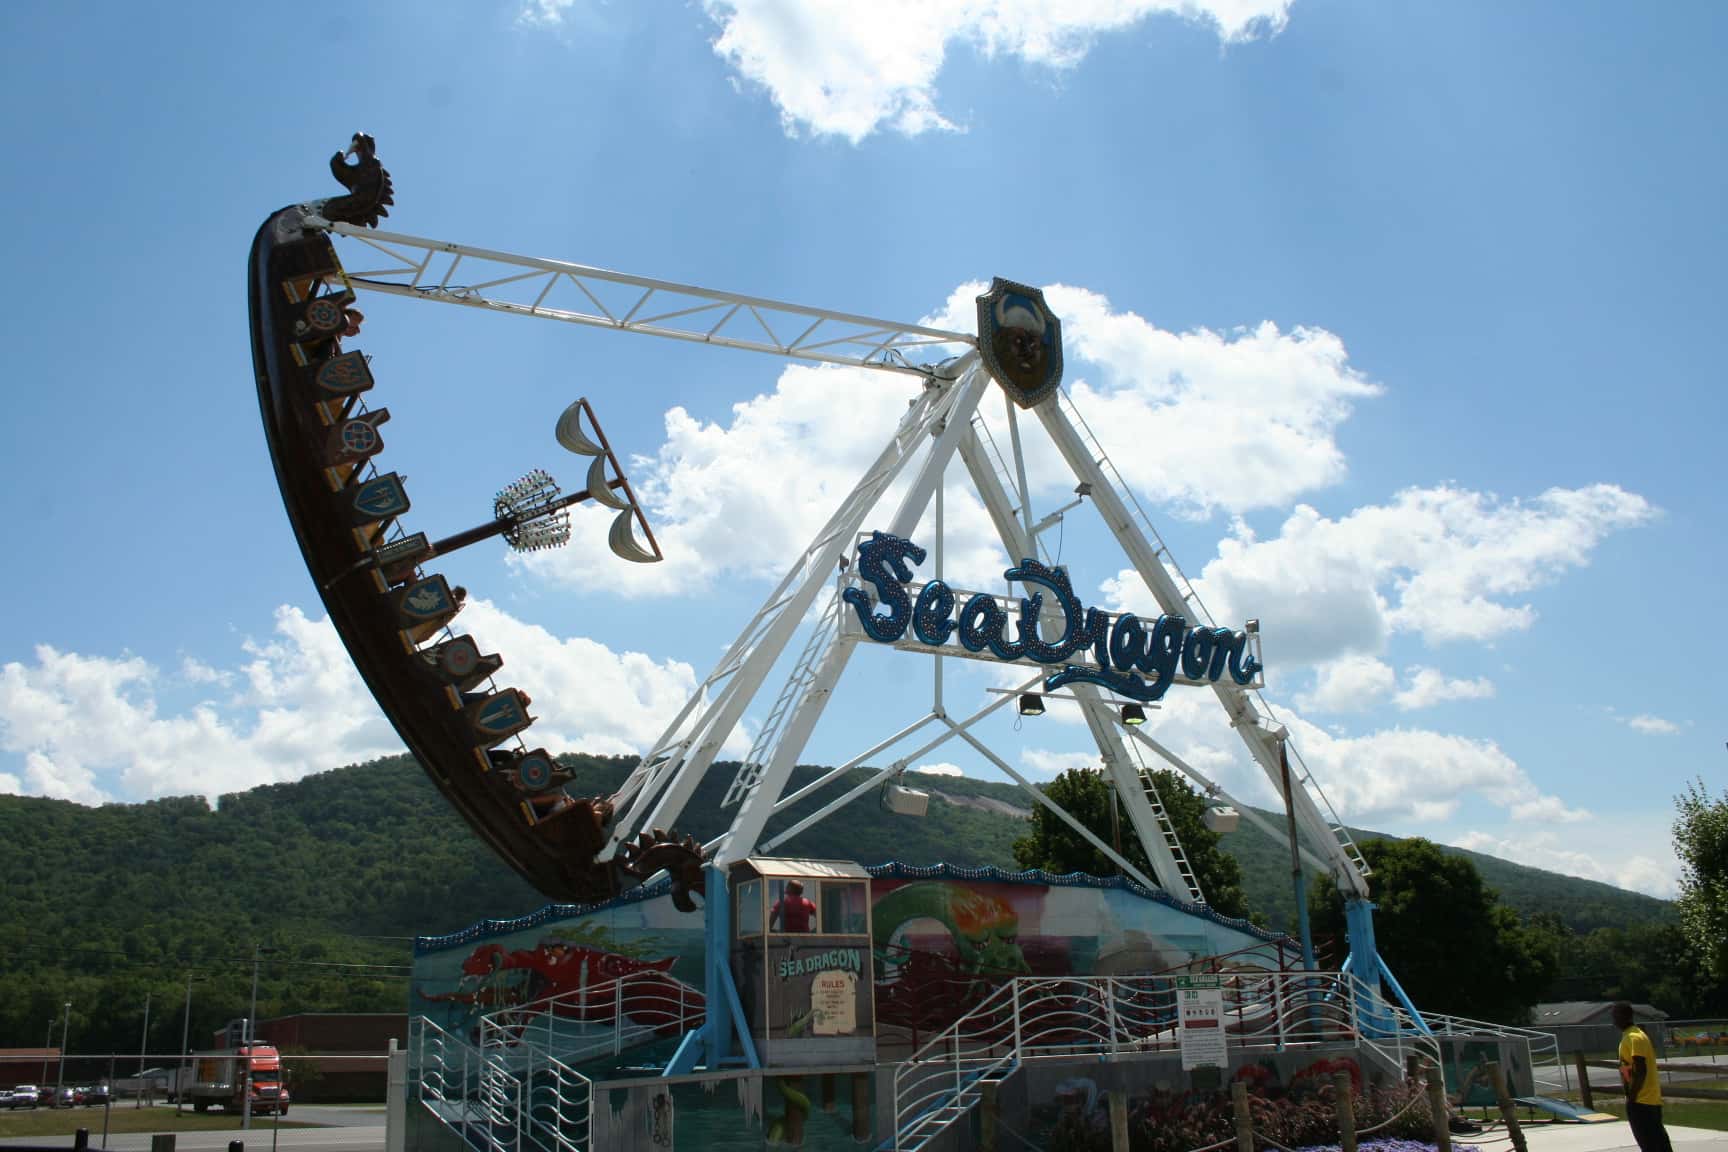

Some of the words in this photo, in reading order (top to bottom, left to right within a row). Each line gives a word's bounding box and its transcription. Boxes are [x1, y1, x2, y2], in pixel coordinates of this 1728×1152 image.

[843, 530, 1025, 660] Sea
[1004, 558, 1263, 701] Dragon
[779, 958, 805, 977] SEA
[805, 949, 861, 974] DRAGON
[821, 980, 845, 988] RULES
